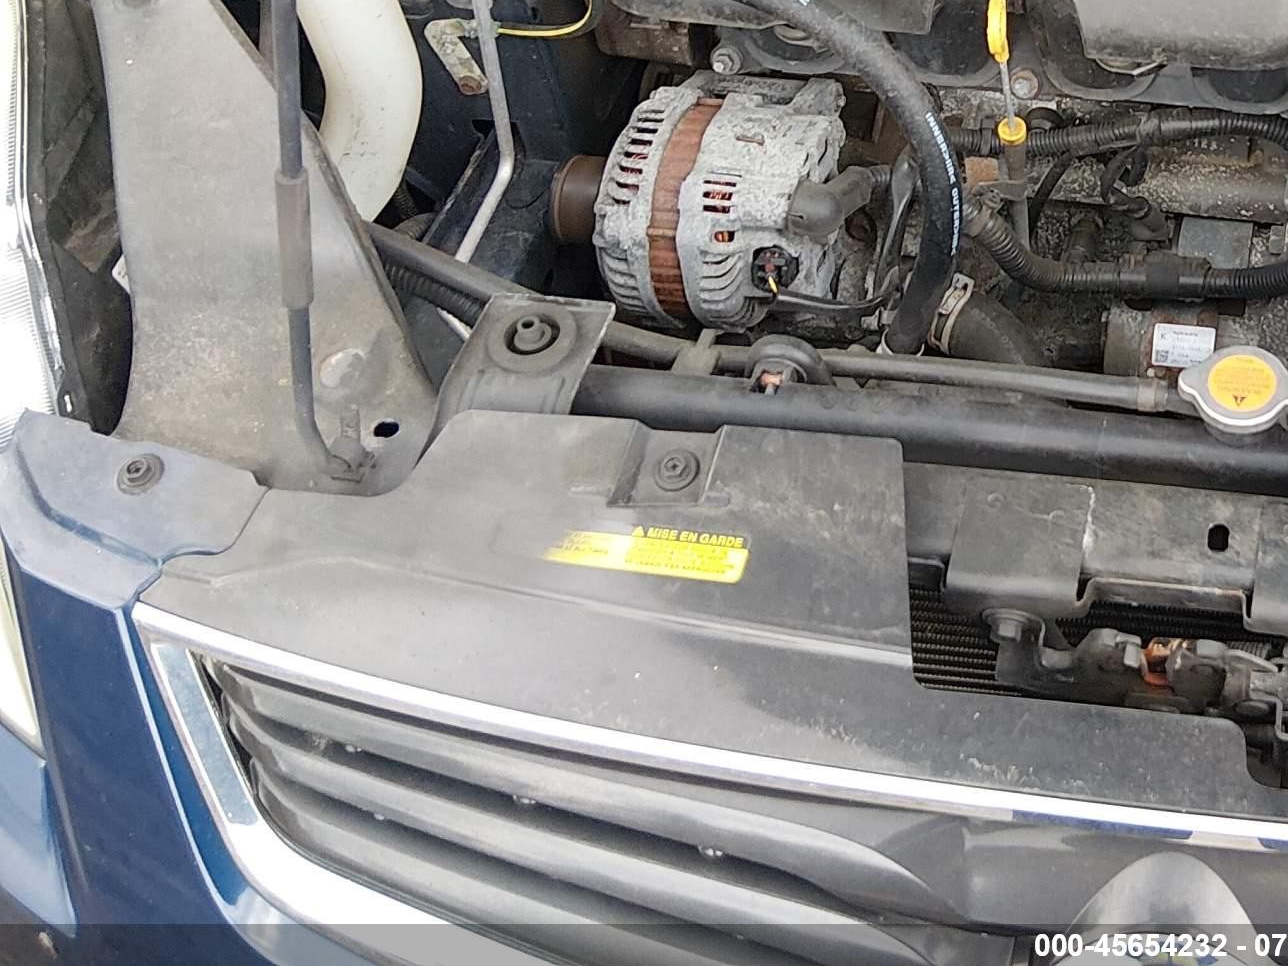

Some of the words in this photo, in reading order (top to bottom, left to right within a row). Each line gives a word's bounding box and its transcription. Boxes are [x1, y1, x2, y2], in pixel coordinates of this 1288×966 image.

[647, 527, 678, 541] MISE
[679, 531, 699, 544] EN
[699, 533, 744, 549] GARDE
